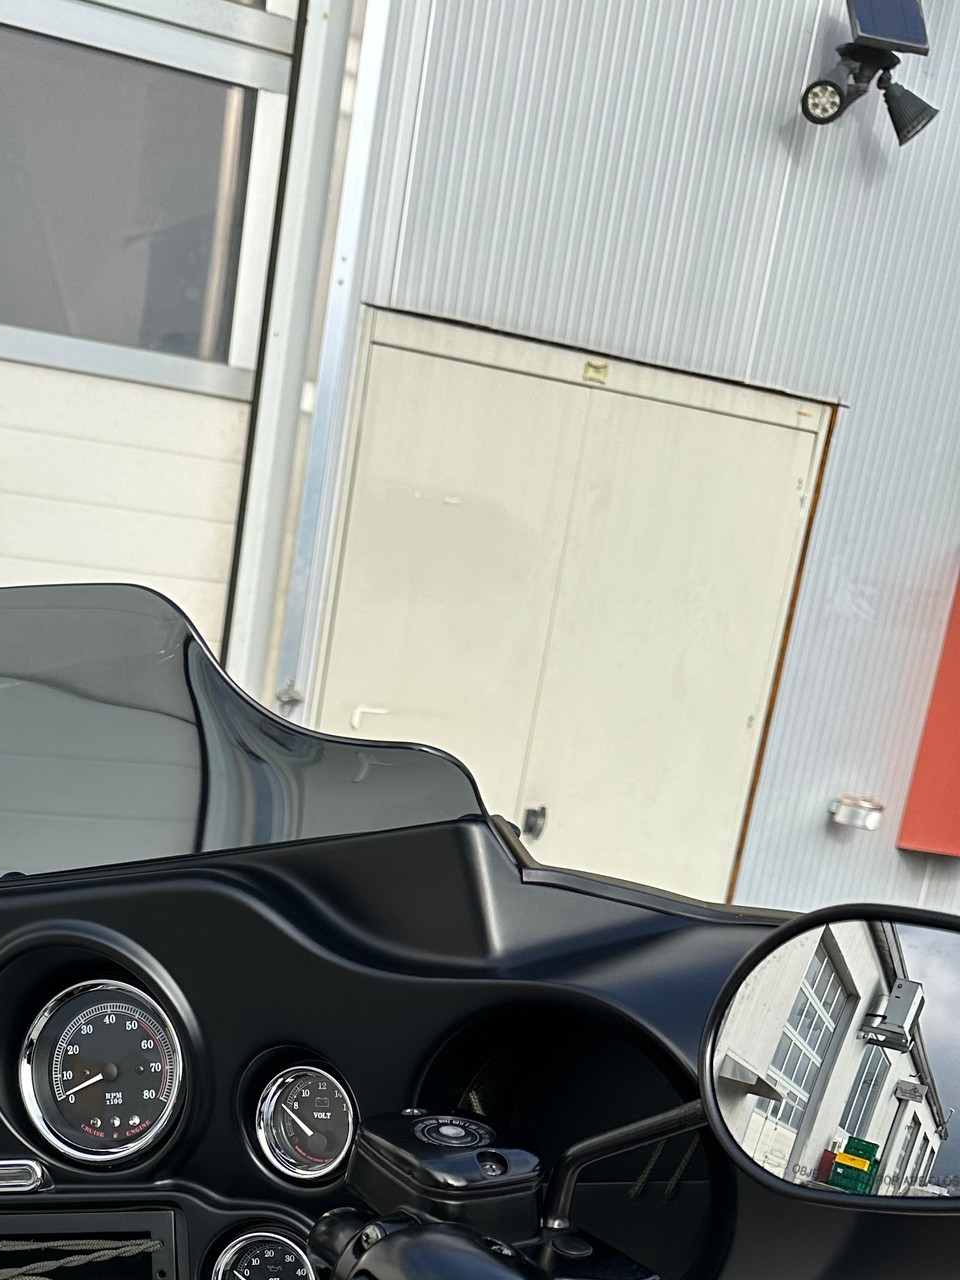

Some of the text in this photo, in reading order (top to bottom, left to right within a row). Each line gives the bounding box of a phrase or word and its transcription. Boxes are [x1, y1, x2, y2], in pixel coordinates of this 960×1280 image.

[103, 1014, 116, 1024] 40
[81, 1025, 93, 1034] 30
[125, 1021, 138, 1030] 50
[141, 1040, 154, 1049] 60
[67, 1045, 79, 1054] 20
[150, 1063, 161, 1072] 70
[62, 1071, 73, 1080] 10
[318, 1082, 327, 1090] 12
[143, 1090, 156, 1099] 80
[301, 1089, 310, 1097] 10
[68, 1095, 75, 1103] 0
[80, 1123, 105, 1138] CRUISE
[125, 1119, 151, 1137] ENGINE
